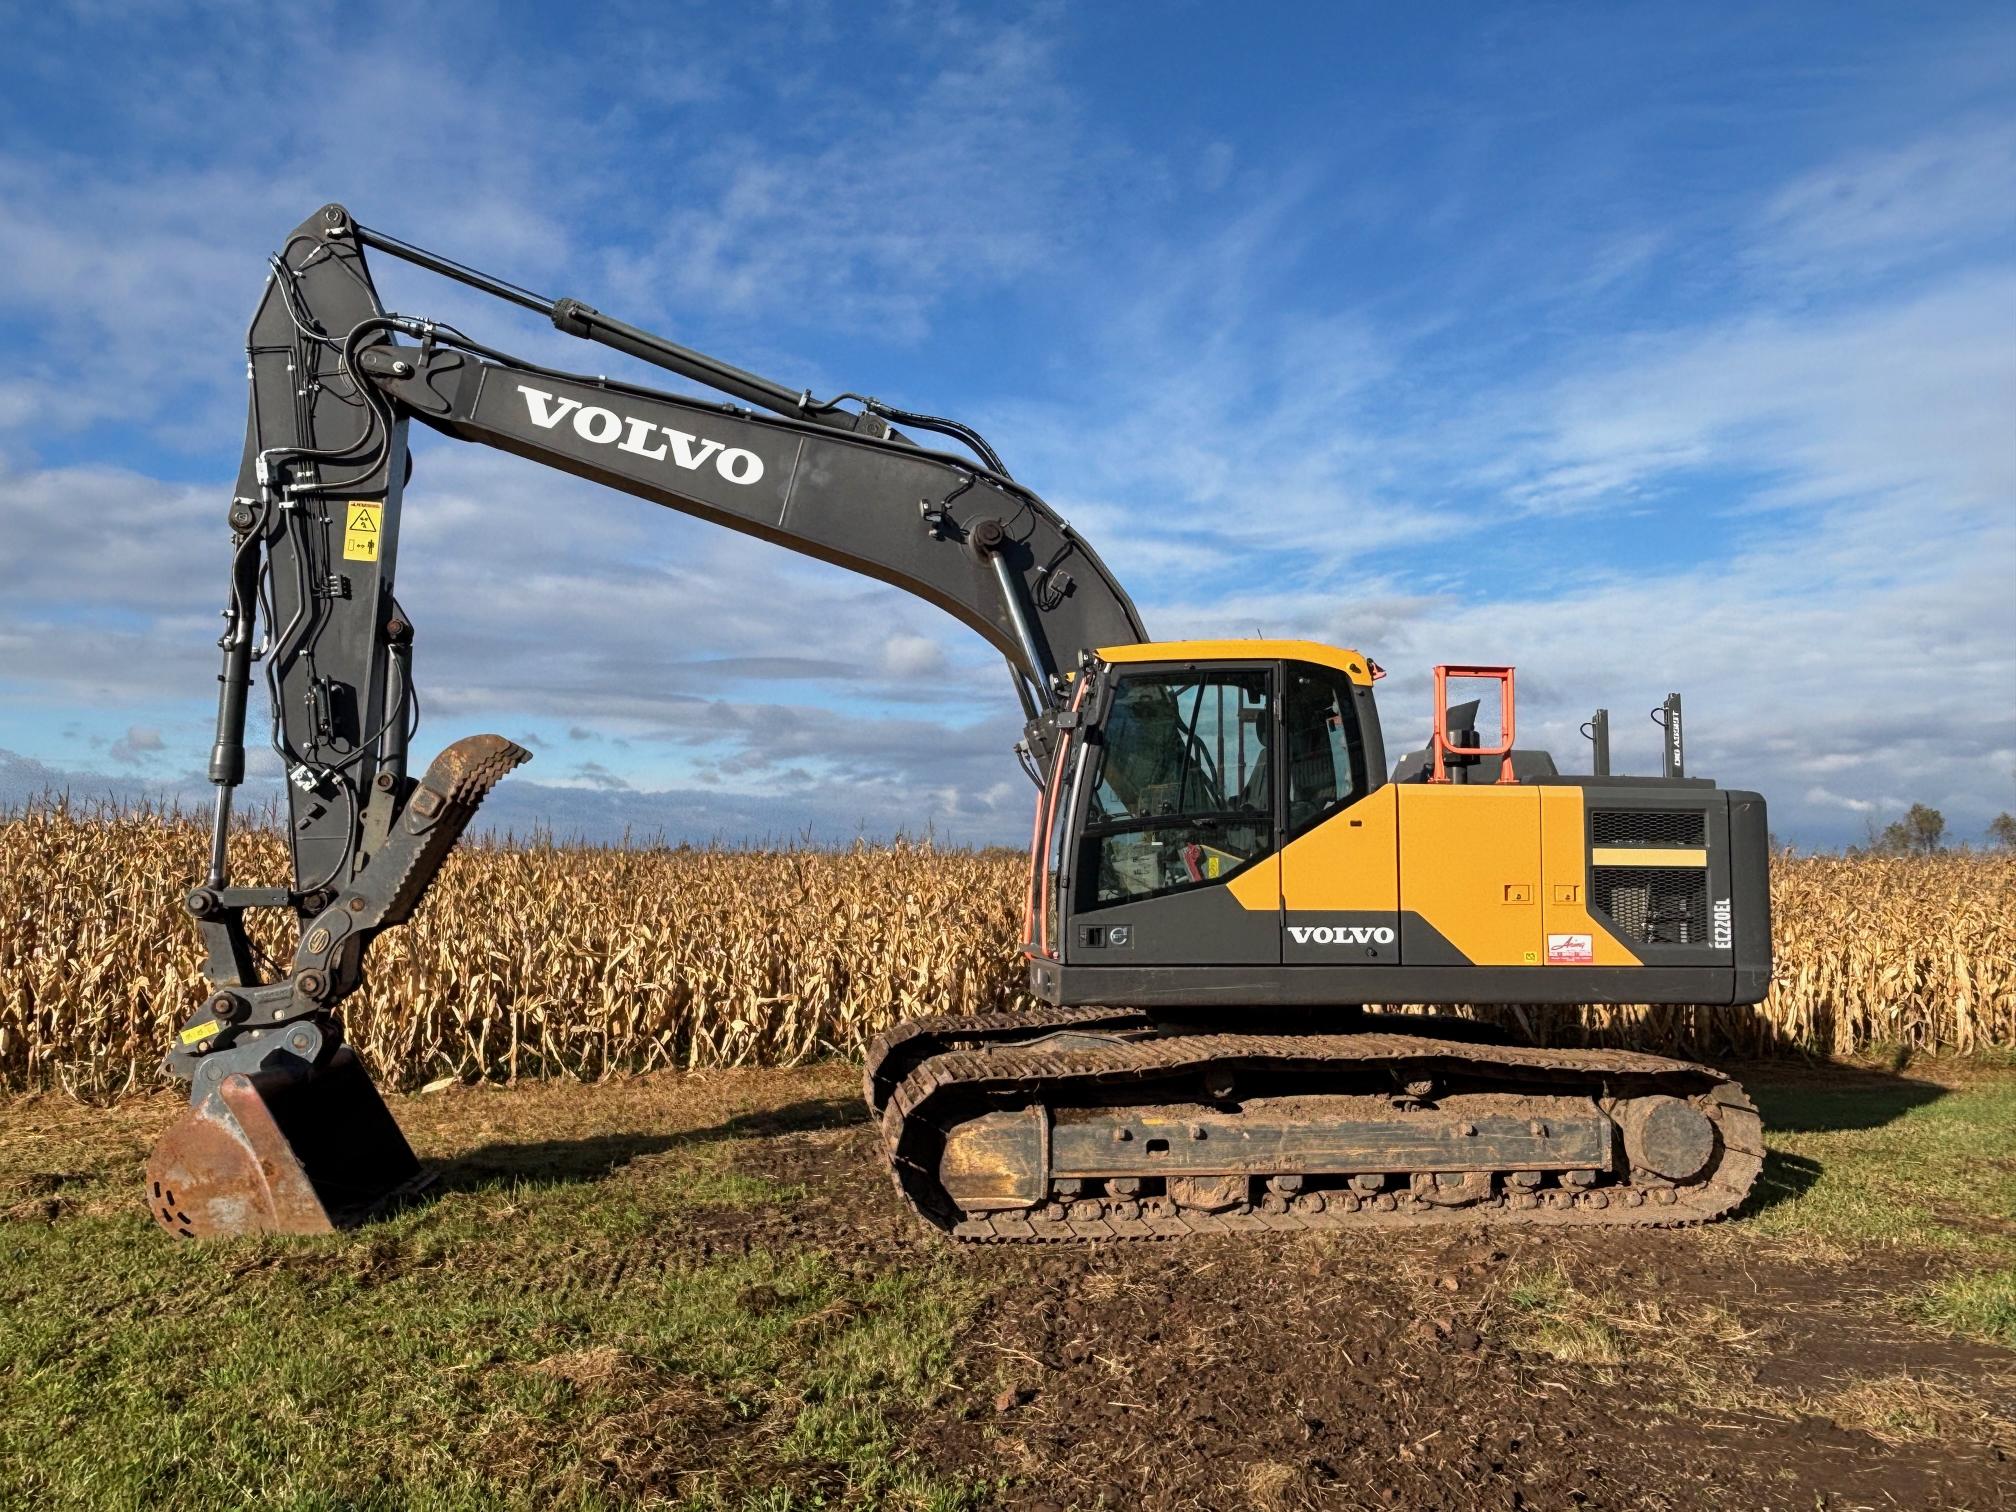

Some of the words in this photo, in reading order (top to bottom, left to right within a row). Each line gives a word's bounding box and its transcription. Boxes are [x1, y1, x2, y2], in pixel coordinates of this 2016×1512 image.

[517, 385, 764, 485] VOLVO
[1287, 926, 1395, 944] VOLVO
[1713, 898, 1732, 949] EC220EL
